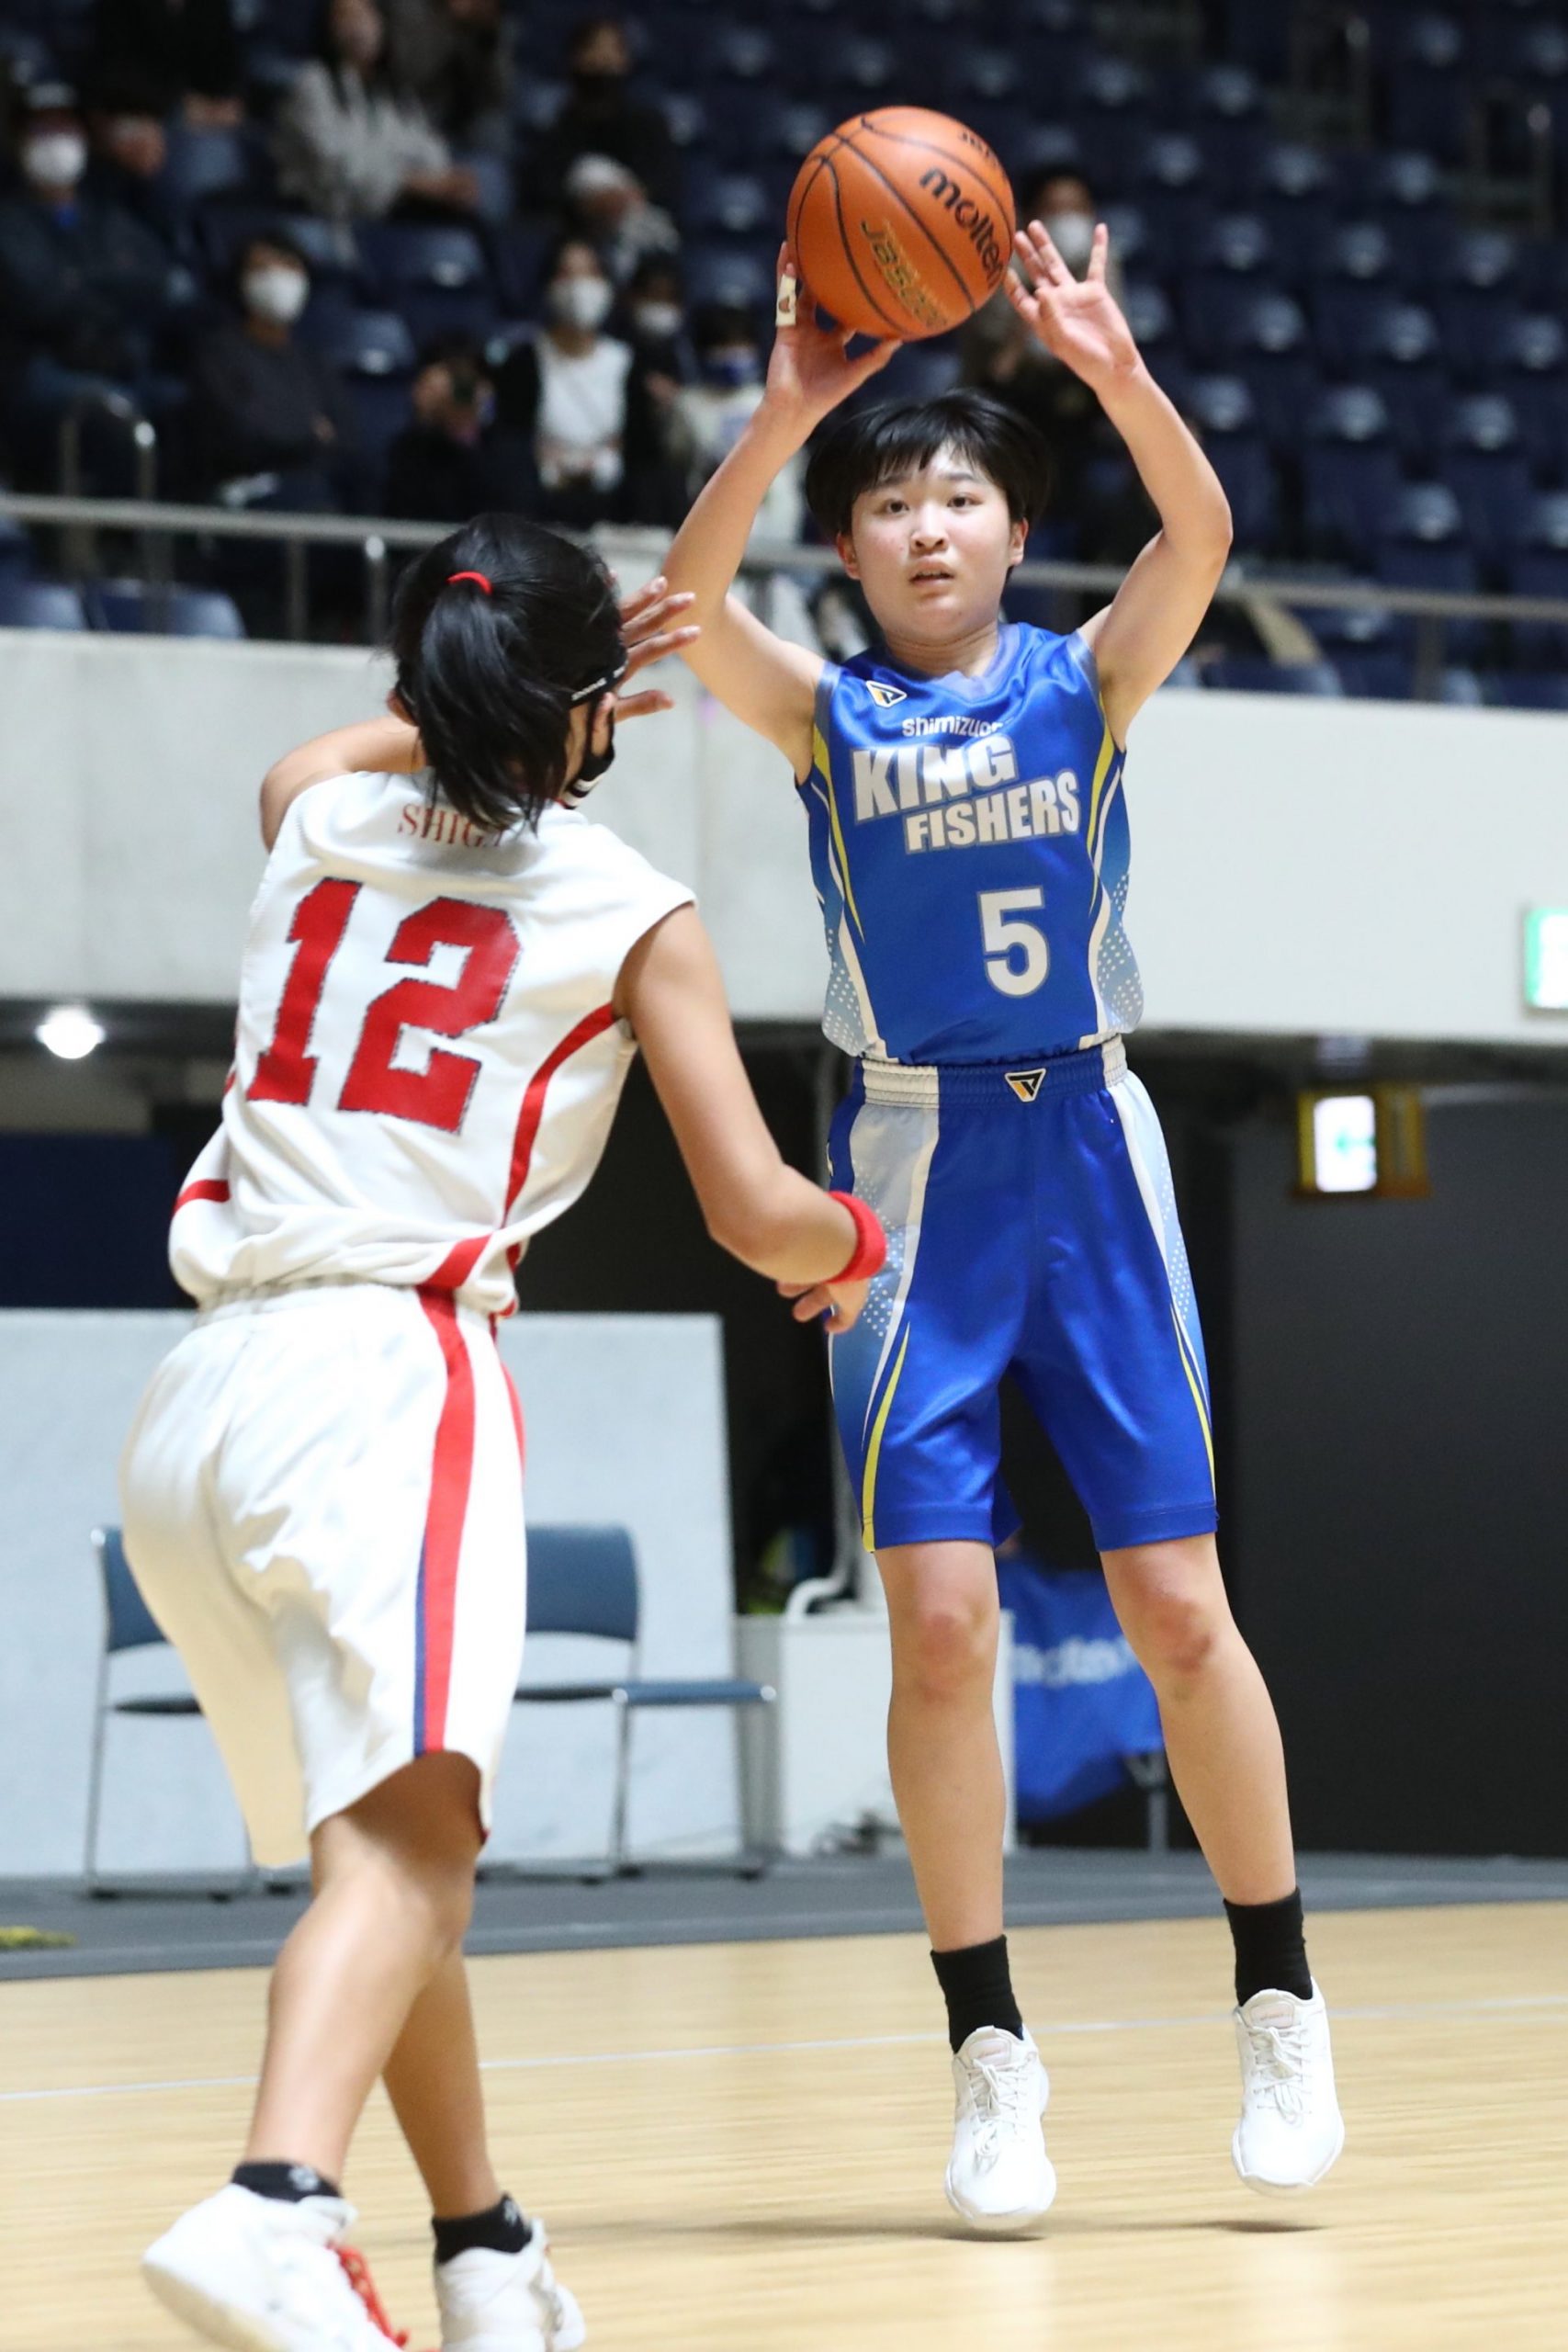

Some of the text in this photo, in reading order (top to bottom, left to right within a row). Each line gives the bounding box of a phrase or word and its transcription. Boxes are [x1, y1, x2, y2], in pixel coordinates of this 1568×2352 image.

[852, 736, 1016, 821] KING
[906, 770, 1080, 853] FISHERS
[398, 803, 503, 847] SHIG
[977, 886, 1051, 998] 5
[246, 876, 524, 1135] 12
